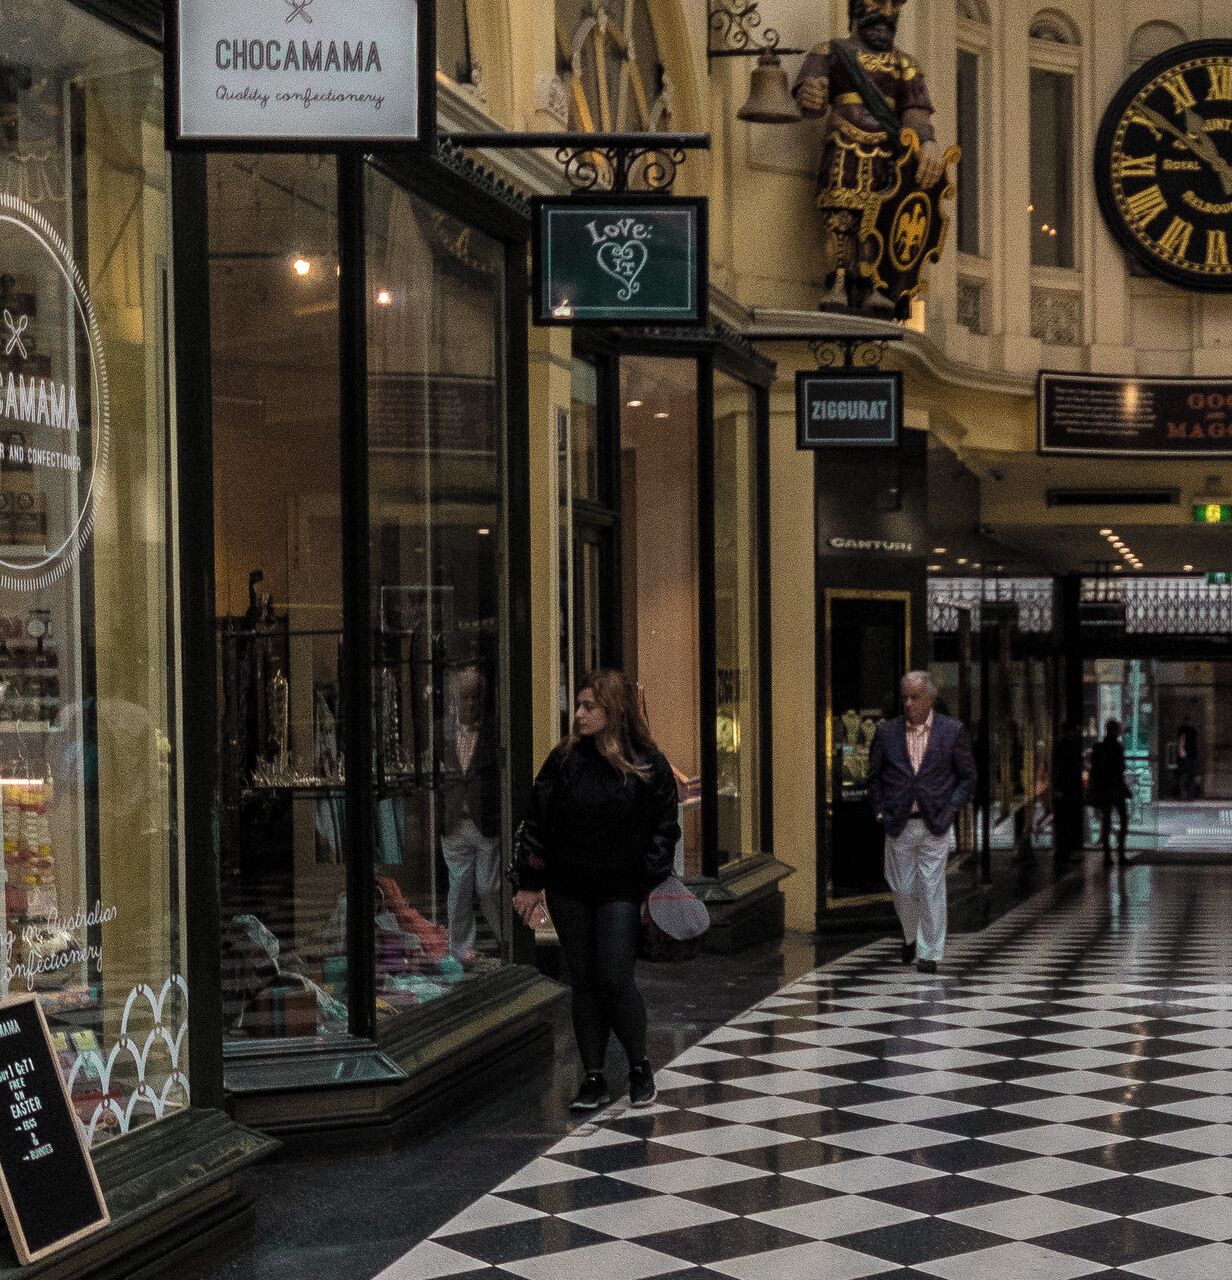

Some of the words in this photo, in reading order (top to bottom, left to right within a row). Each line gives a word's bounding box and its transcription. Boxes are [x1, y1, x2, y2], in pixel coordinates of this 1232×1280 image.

[216, 39, 382, 72] CHOCAMAMA
[216, 84, 270, 109] Quality
[275, 87, 385, 110] confectionery
[1161, 73, 1197, 115] XI
[812, 400, 888, 420] ZIGGURAT
[9, 444, 24, 464] AND
[28, 446, 81, 472] CONFECTIONER
[47, 899, 117, 935] Australian
[0, 946, 103, 991] onfectionery
[8, 1076, 26, 1091] FREE
[13, 1089, 26, 1102] ON
[9, 1095, 43, 1120] EASTER
